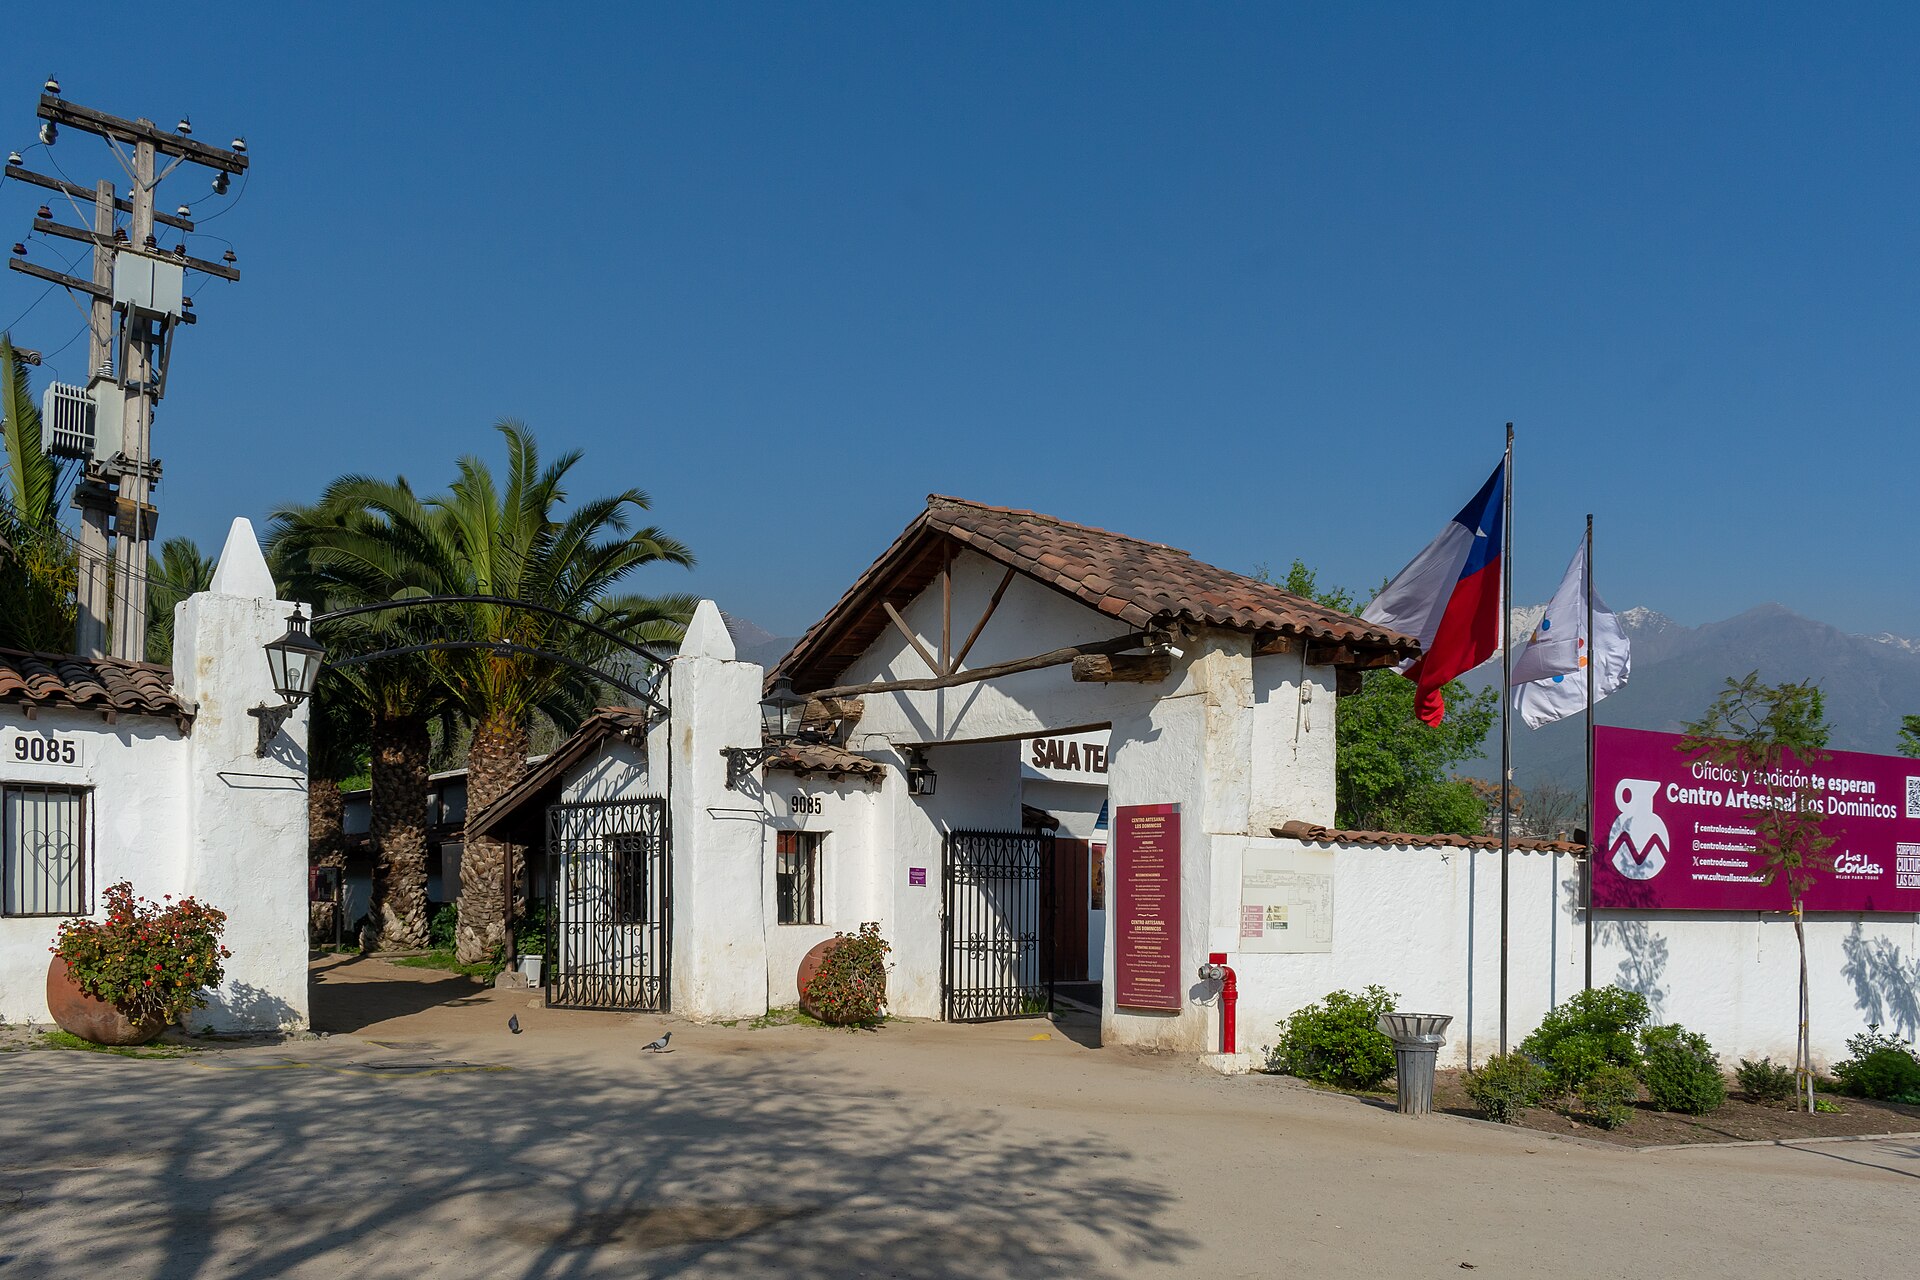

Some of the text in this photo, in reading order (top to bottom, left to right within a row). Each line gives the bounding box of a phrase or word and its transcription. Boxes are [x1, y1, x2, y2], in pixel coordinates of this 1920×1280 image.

[15, 736, 75, 764] 9085
[1032, 738, 1081, 771] SALA
[1692, 760, 1738, 783] Oficios
[1741, 770, 1750, 788] y
[1811, 774, 1825, 789] te
[1828, 777, 1875, 796] esperan
[791, 795, 822, 815] 9085
[1666, 782, 1897, 819] Centro Artesanal Los Dominicos
[1700, 824, 1757, 836] centrolosdominicos
[1699, 858, 1749, 868] centrodominicos
[1845, 849, 1862, 862] Las
[1896, 874, 1908, 886] LAS
